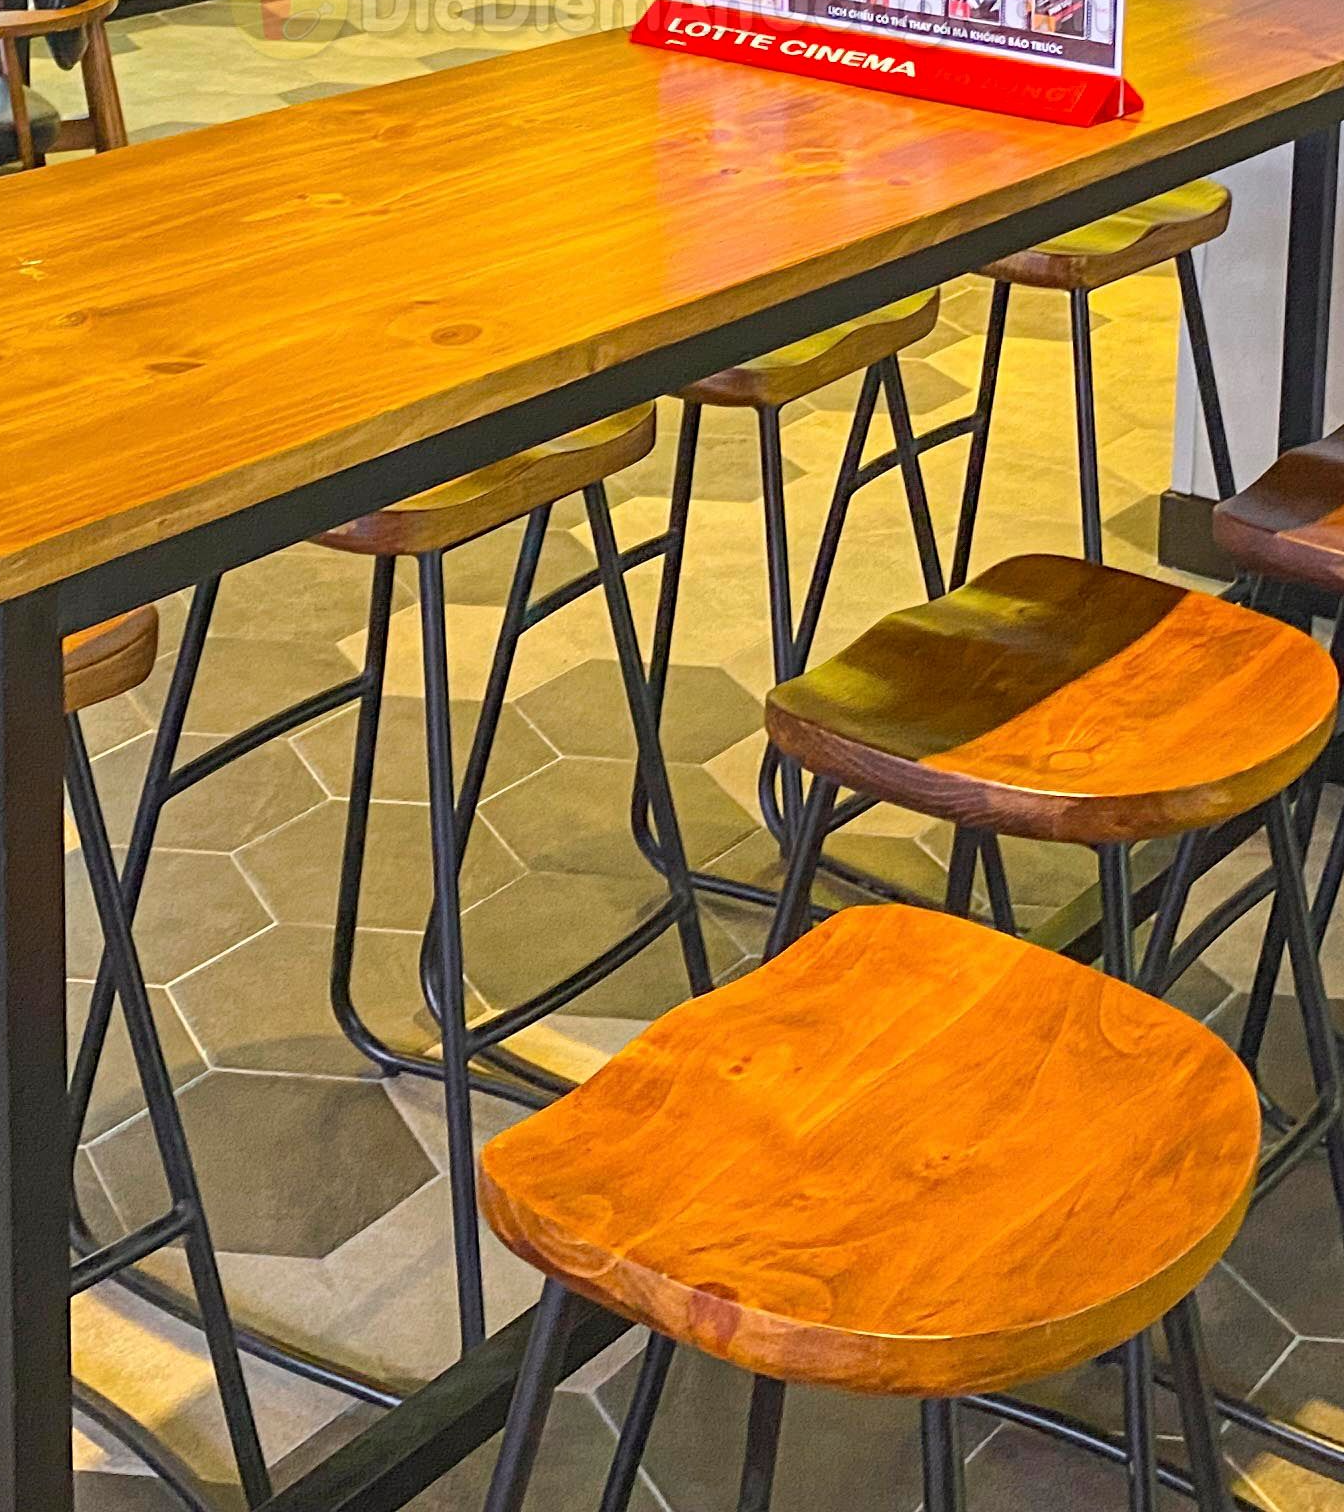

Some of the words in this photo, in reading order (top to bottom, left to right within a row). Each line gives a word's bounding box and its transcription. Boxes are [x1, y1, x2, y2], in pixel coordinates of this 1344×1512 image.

[667, 17, 776, 51] LOTTE
[780, 40, 916, 77] CINEMA
[828, 5, 847, 17] LỊCH
[876, 13, 889, 25] CÓ
[909, 20, 932, 32] THAY
[970, 29, 1006, 45] KHÔNG
[1008, 36, 1030, 49] BÁO
